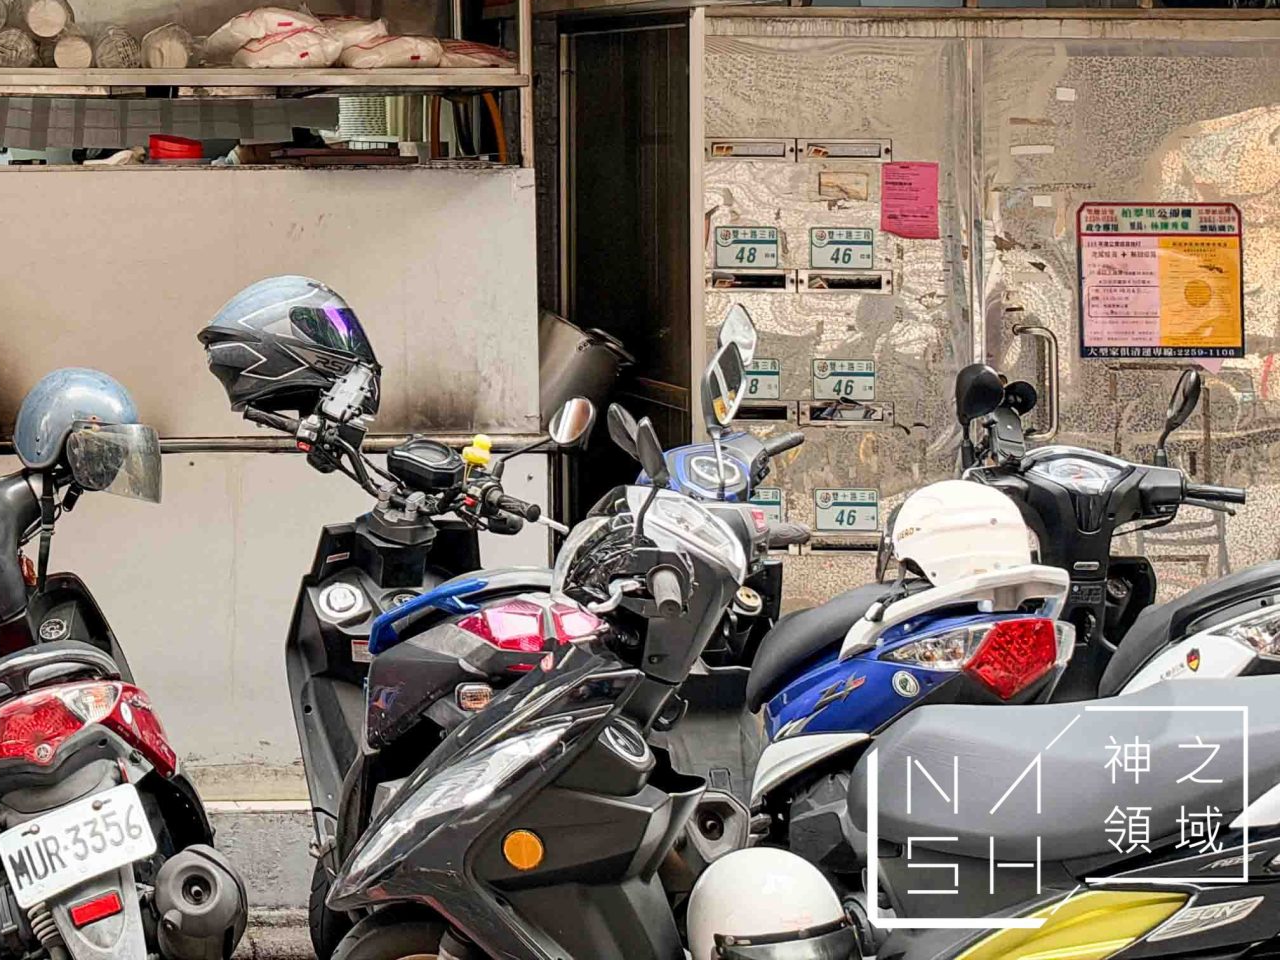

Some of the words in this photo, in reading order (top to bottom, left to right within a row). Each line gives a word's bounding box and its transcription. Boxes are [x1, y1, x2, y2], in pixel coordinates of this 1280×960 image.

[735, 247, 758, 264] 48
[830, 247, 853, 265] 46
[832, 379, 855, 396] 46
[835, 509, 857, 526] 46
